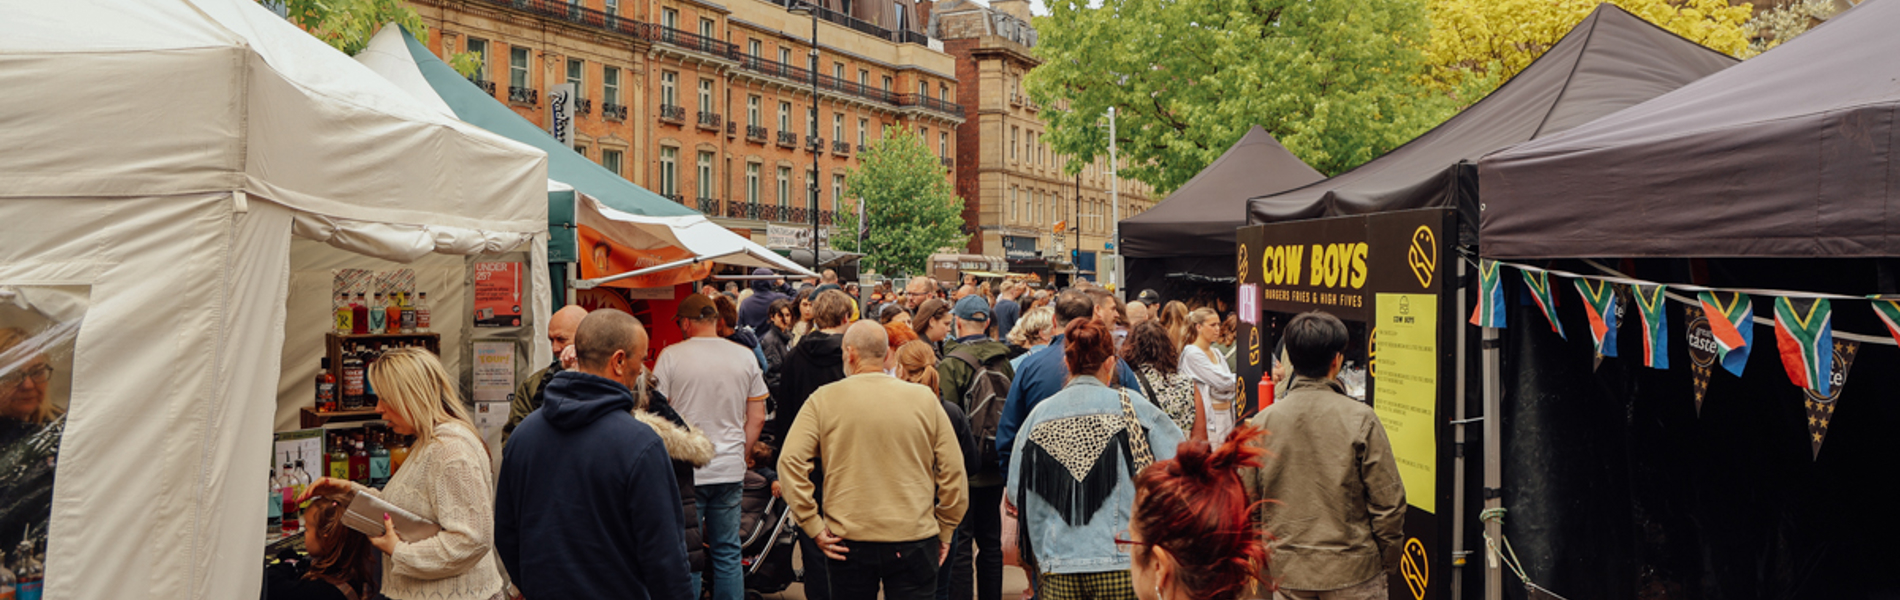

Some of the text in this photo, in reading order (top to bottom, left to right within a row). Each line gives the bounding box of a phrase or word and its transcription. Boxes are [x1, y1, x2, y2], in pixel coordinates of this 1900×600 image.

[476, 262, 507, 271] UNDER
[1262, 242, 1368, 289] COW BOYS
[476, 271, 491, 280] 25?
[1265, 289, 1363, 308] BURGERS FRIES & HIGH FIVES
[1689, 334, 1717, 353] taste
